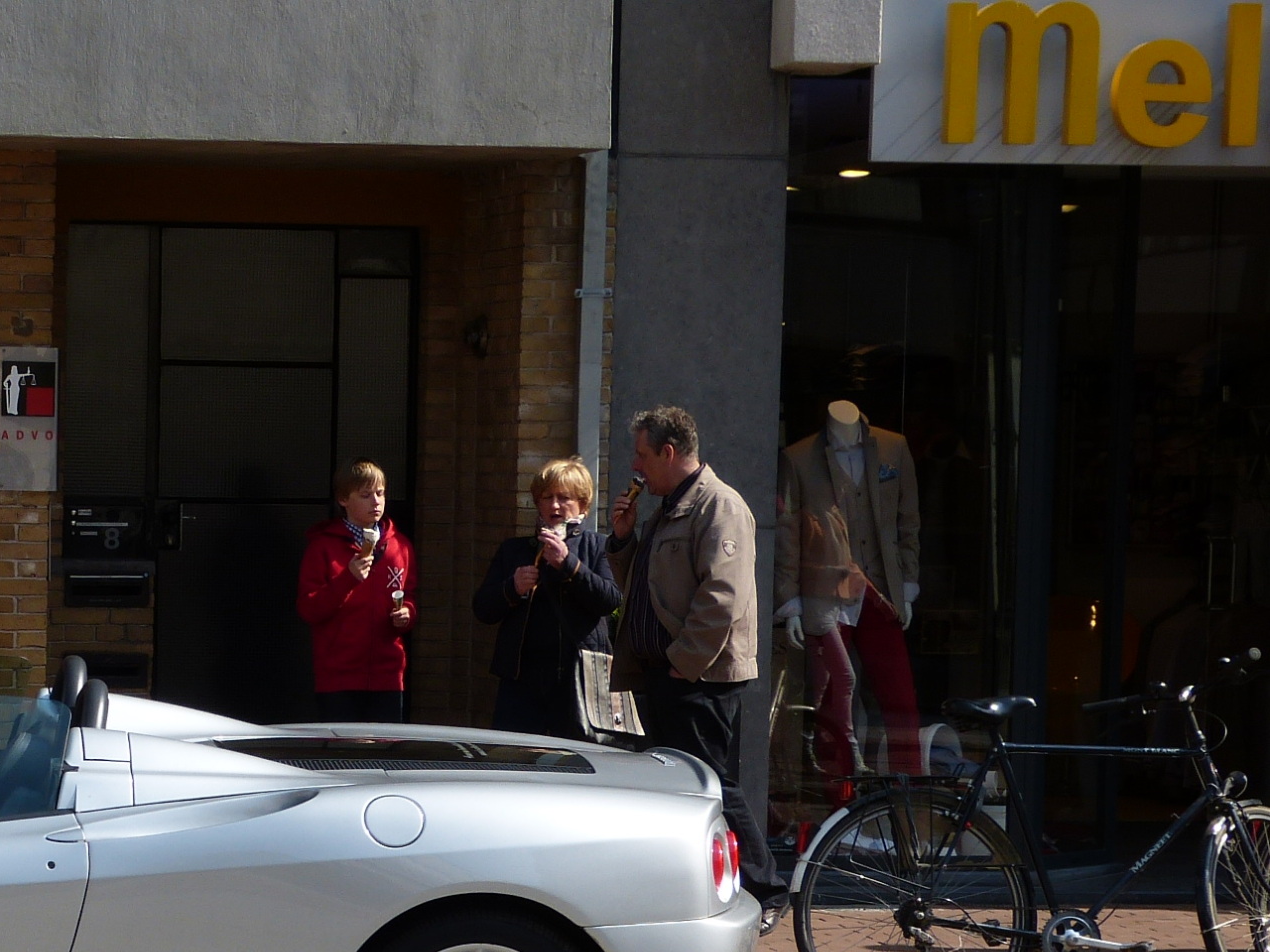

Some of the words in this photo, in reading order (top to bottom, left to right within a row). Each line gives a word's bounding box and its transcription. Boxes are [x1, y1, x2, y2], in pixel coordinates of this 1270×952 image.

[1, 429, 53, 441] ADVO
[104, 527, 120, 550] 8
[1130, 831, 1172, 873] MAGNEET
